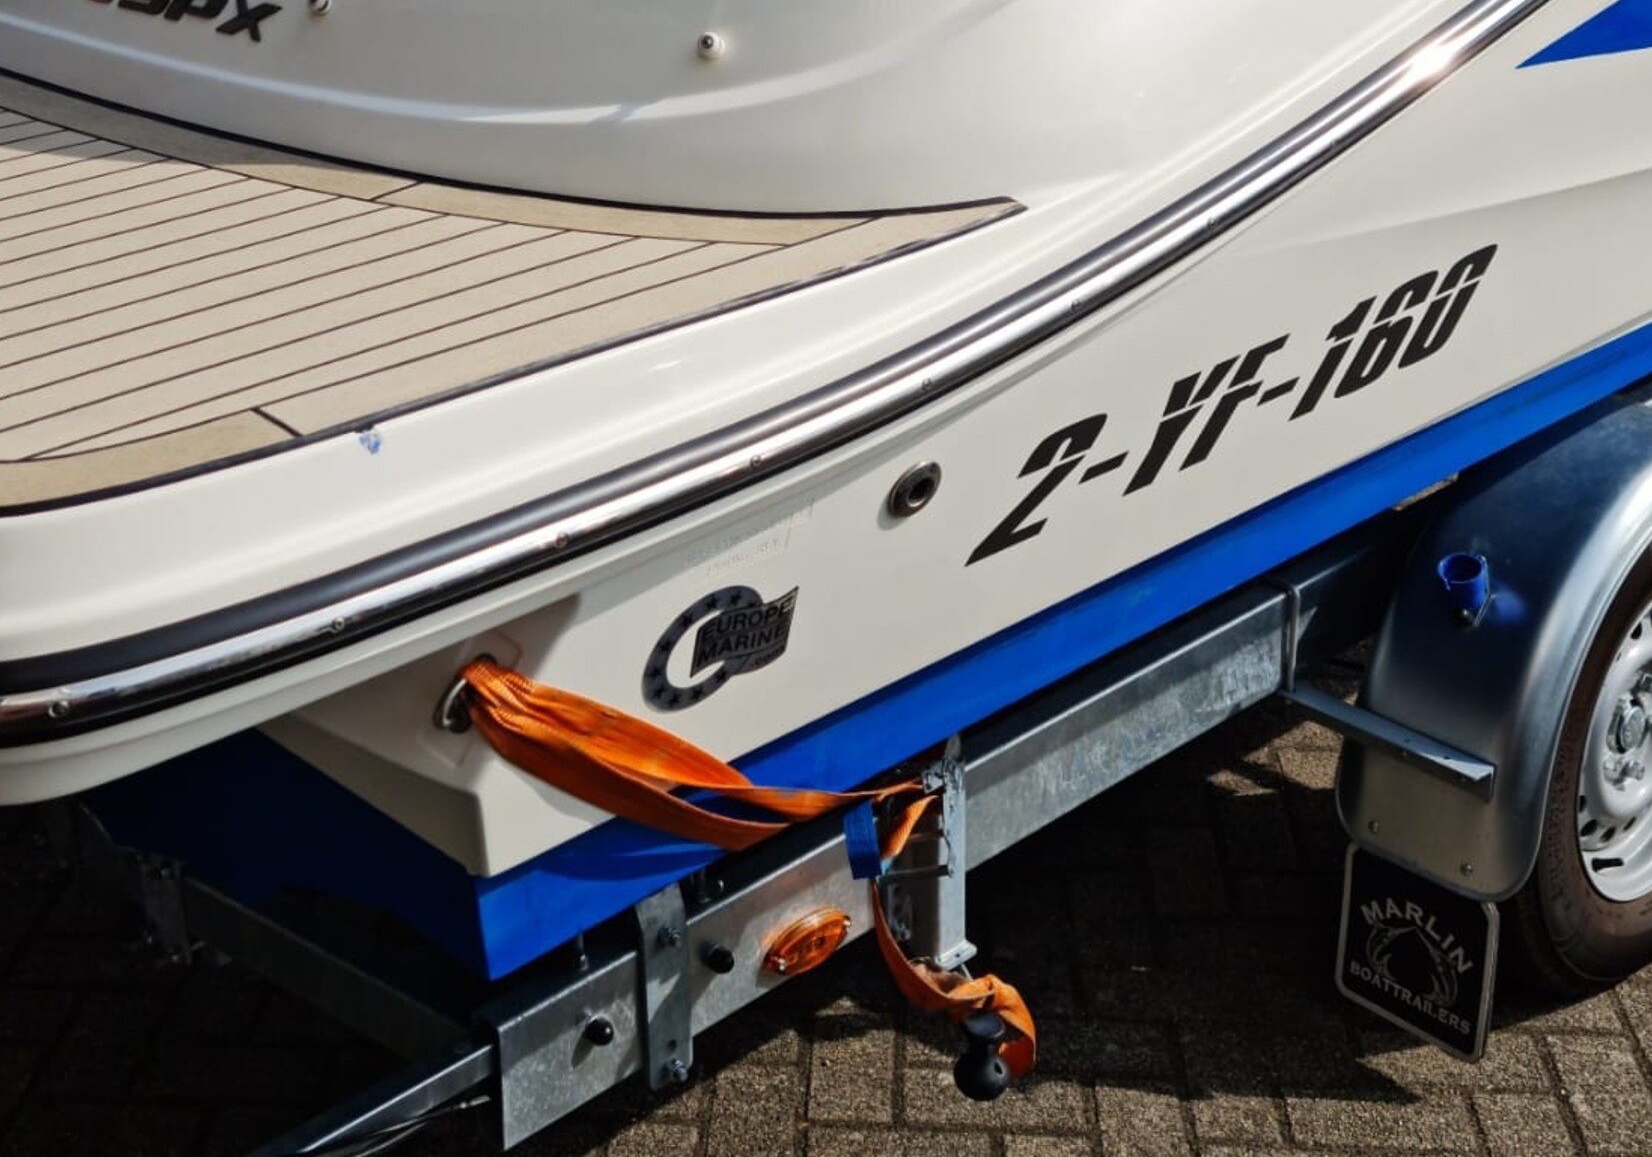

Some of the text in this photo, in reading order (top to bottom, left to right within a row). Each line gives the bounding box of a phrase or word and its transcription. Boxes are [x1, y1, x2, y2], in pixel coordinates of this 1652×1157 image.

[696, 623, 785, 668] MARINE
[700, 594, 794, 643] EUROPE
[1360, 897, 1475, 975] MARLIN
[1349, 960, 1472, 1035] BOATTRAILERS
